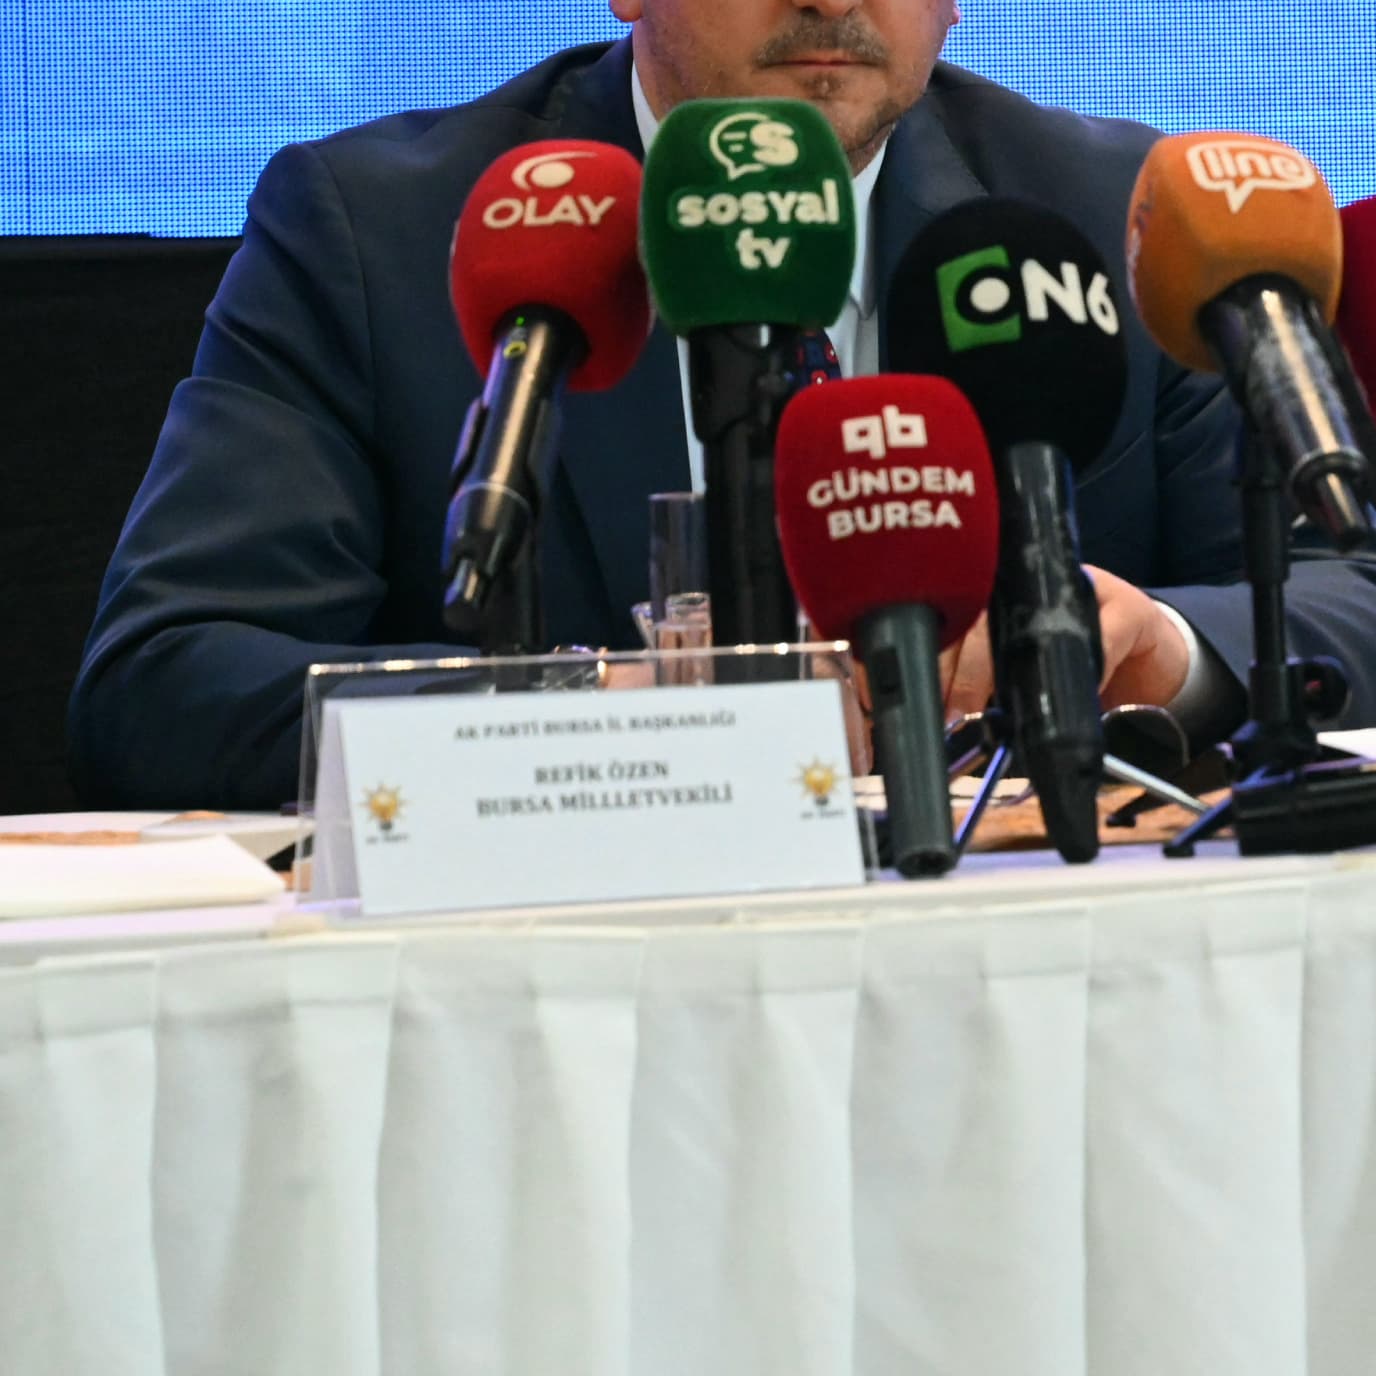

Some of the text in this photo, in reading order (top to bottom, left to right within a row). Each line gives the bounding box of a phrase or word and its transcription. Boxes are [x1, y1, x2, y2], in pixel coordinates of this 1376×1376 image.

[482, 195, 616, 229] OLAY
[806, 466, 976, 508] GÜNDEM
[827, 499, 963, 541] BURSA
[454, 726, 480, 741] AK
[483, 717, 540, 739] PARTİ
[543, 715, 603, 735] BURSA
[628, 709, 737, 734] BAŞKANLIĞI
[534, 756, 670, 785] REFİK ÖZEN
[476, 795, 553, 818] BURSA
